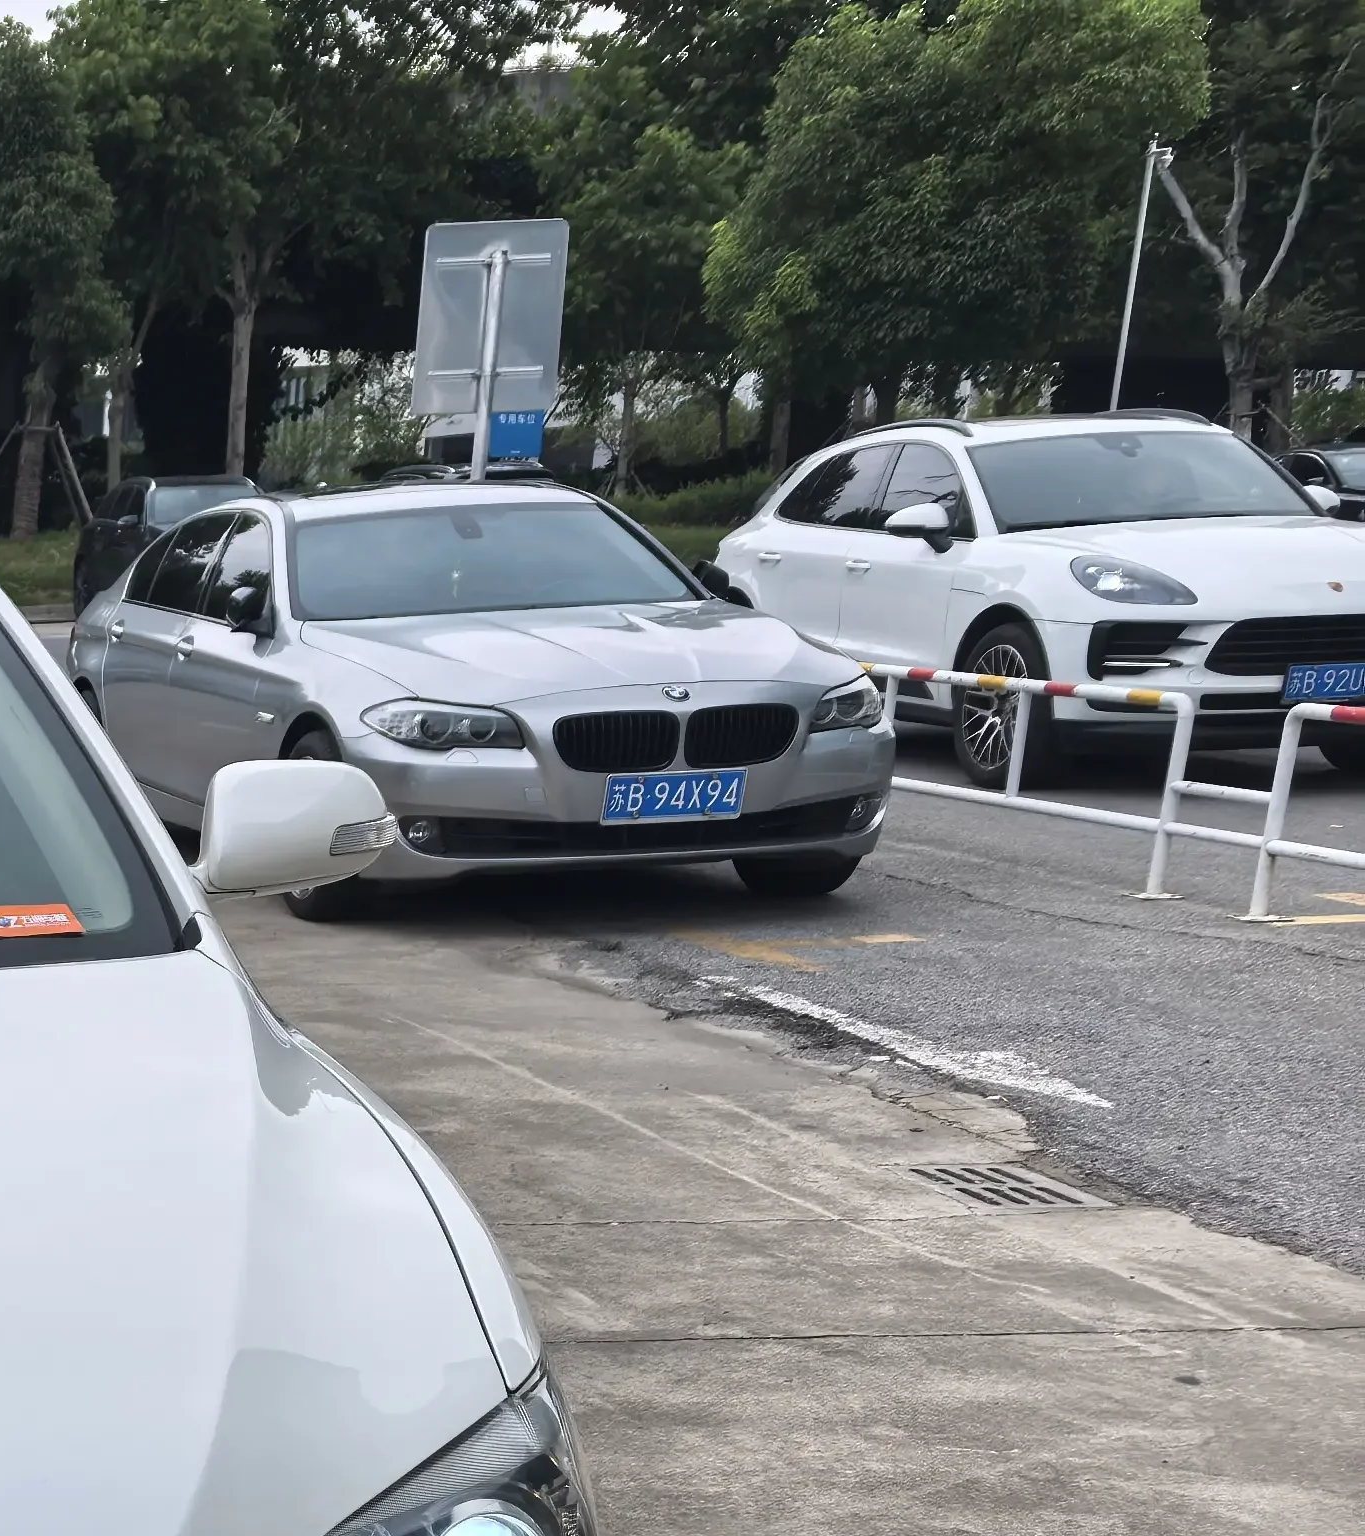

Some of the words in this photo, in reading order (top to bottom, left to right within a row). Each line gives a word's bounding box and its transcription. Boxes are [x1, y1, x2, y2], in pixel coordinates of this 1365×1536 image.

[499, 413, 536, 425] 专用车位
[1287, 666, 1365, 696] 苏B·92U
